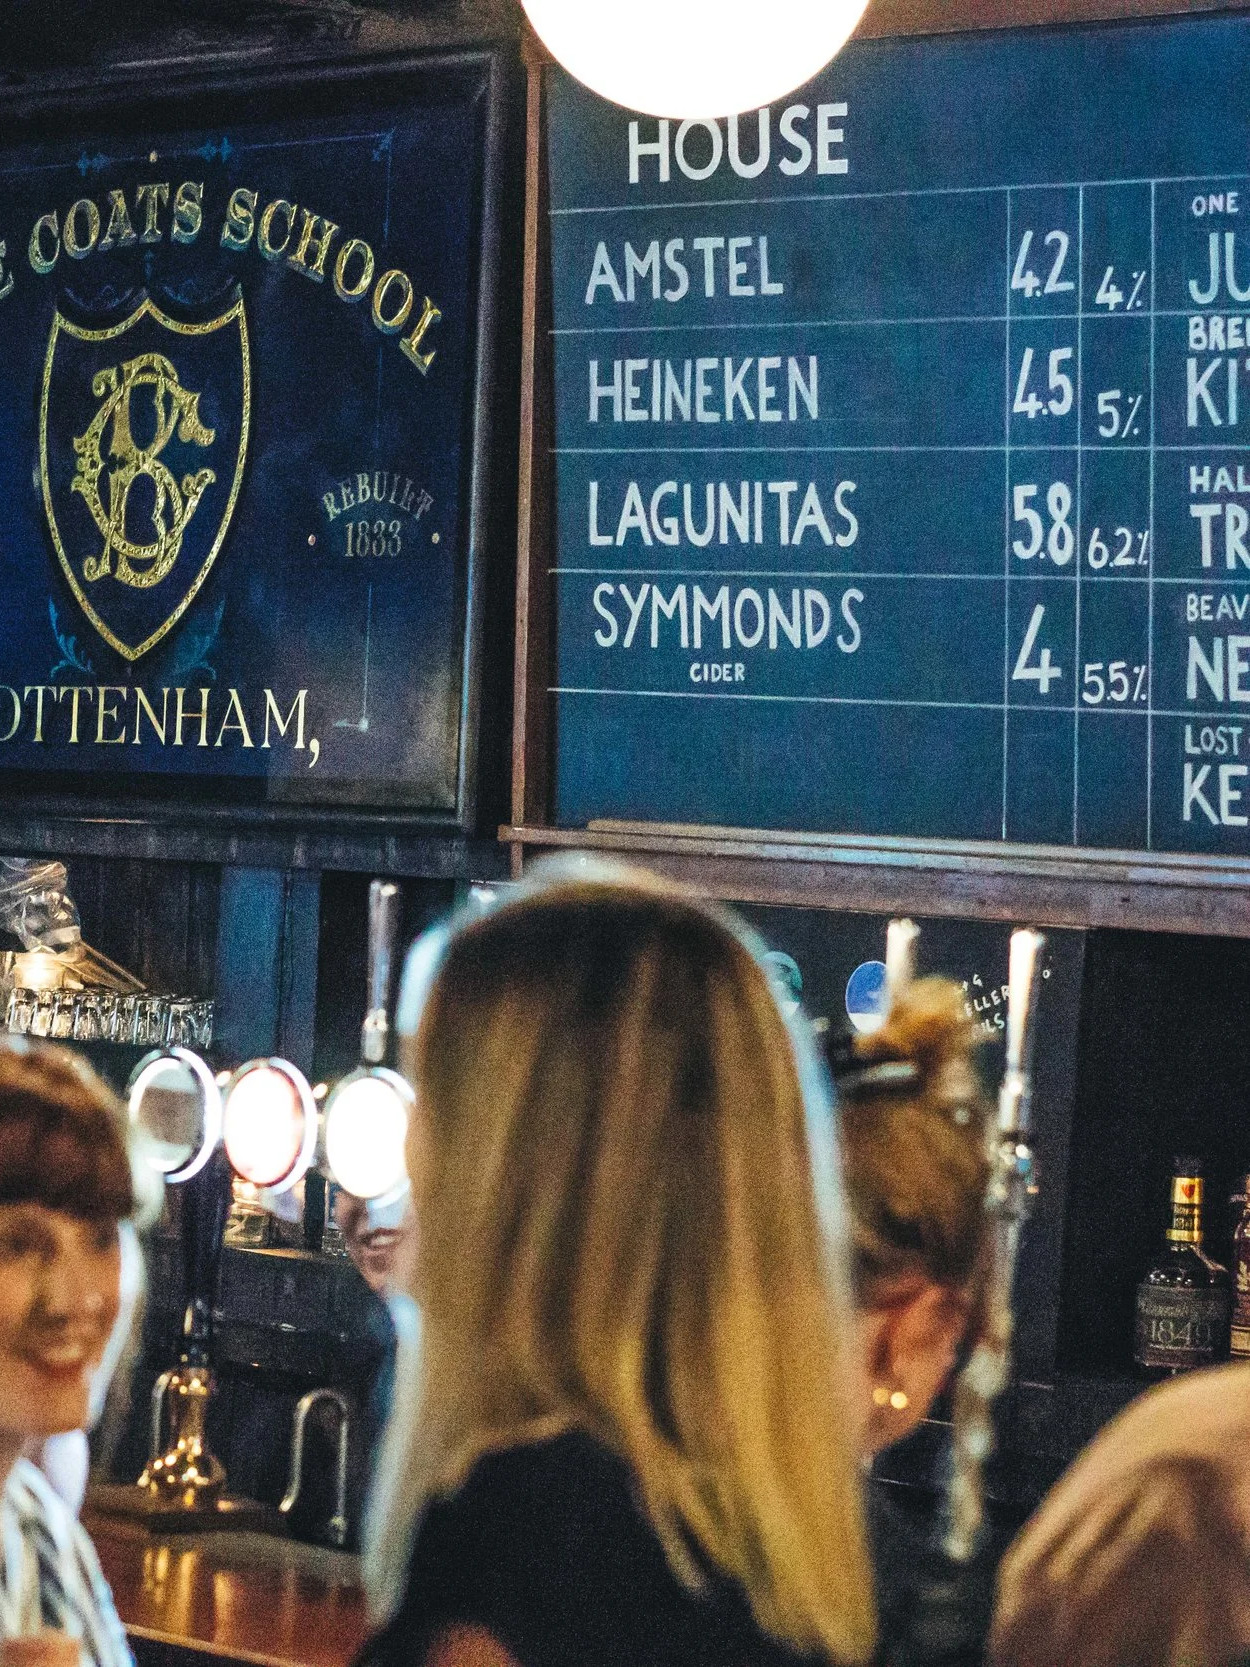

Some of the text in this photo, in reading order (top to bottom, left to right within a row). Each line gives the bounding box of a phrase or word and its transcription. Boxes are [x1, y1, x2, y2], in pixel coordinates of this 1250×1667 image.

[629, 102, 848, 183] HOUSE
[1191, 192, 1240, 217] ONE
[28, 182, 204, 274] COATS
[220, 188, 442, 375] SCHOOL
[585, 236, 784, 304] AMSTEL
[1011, 230, 1075, 298] 4.2
[1095, 266, 1146, 311] 4%
[1188, 316, 1250, 350] BRE
[589, 355, 819, 422] HEINEKEN
[1013, 347, 1074, 419] 4.5
[1097, 389, 1142, 438] 5%
[1187, 357, 1250, 427] KI
[322, 471, 434, 521] REBUILT
[589, 480, 858, 547] LAGUNITAS
[1012, 482, 1074, 564] 5.8
[345, 520, 402, 556] 1833
[1088, 527, 1149, 570] 6.2%
[593, 582, 864, 653] SYMMONDS
[1012, 604, 1061, 693] 4
[689, 662, 746, 683] CIDER
[1186, 635, 1250, 702] NE
[1185, 725, 1243, 756] LOST
[1183, 763, 1249, 826] KE
